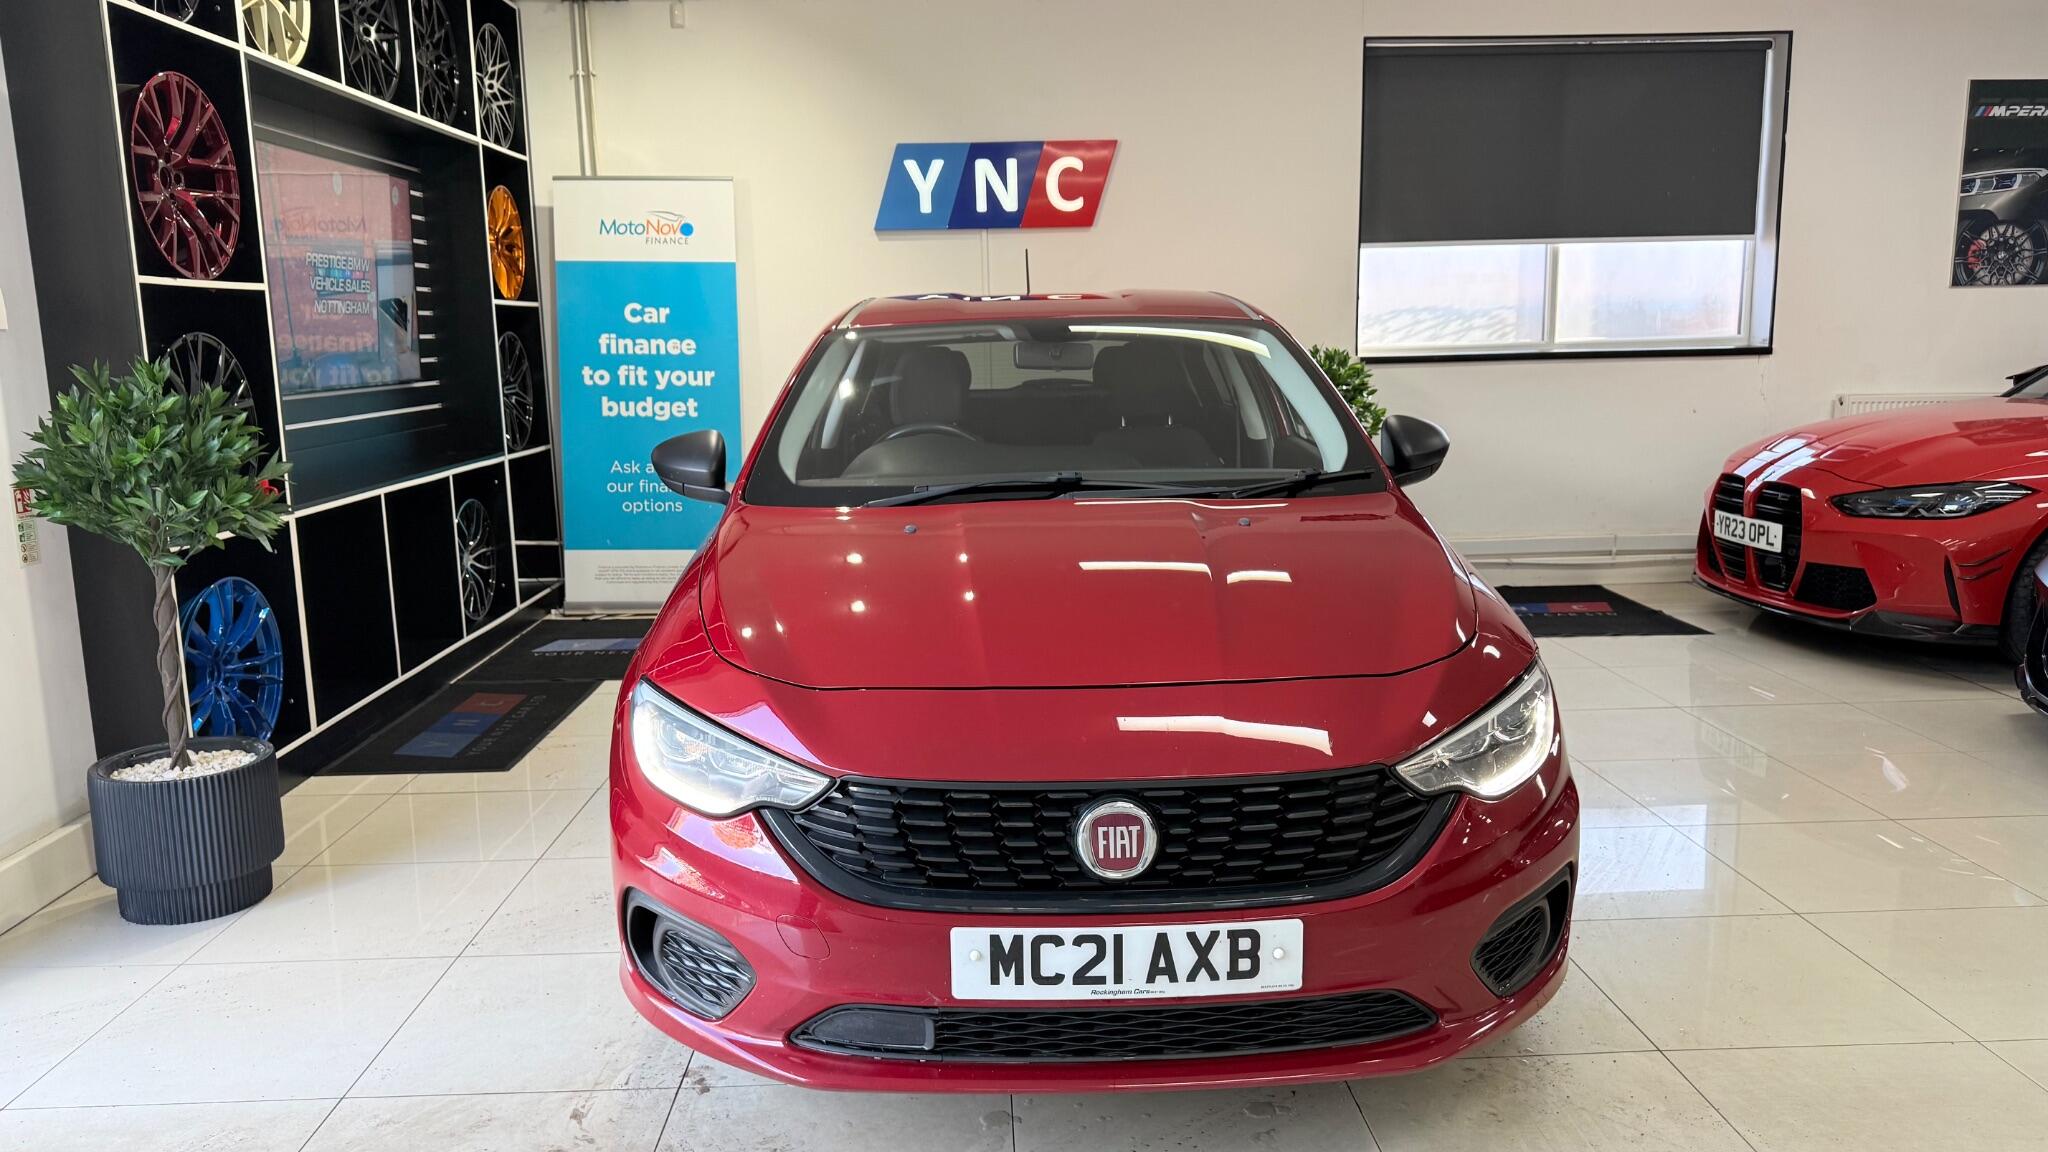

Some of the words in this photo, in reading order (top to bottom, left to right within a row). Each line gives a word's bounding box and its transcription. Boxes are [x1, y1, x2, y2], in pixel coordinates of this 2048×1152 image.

[903, 156, 1084, 214] YNC
[645, 237, 689, 245] FINANCE
[305, 252, 347, 269] PRESTIGE
[347, 256, 370, 272] BMW
[310, 276, 345, 292] VEHICLE
[345, 278, 371, 293] SALES
[314, 299, 370, 314] NOTTINGHAM
[623, 302, 670, 323] Car
[598, 333, 696, 355] finance
[582, 366, 611, 386] to
[617, 365, 648, 386] fit
[654, 369, 715, 390] your
[601, 396, 698, 421] budget
[610, 460, 641, 474] Ask
[606, 482, 634, 493] our
[639, 479, 672, 493] fina
[622, 499, 683, 514] options
[1718, 514, 1746, 540] YR23
[1748, 522, 1775, 547] OPL
[1097, 825, 1141, 859] FIAT
[989, 934, 1124, 986] MC21
[1145, 928, 1262, 984] AXB
[1090, 988, 1133, 996] Rockingham
